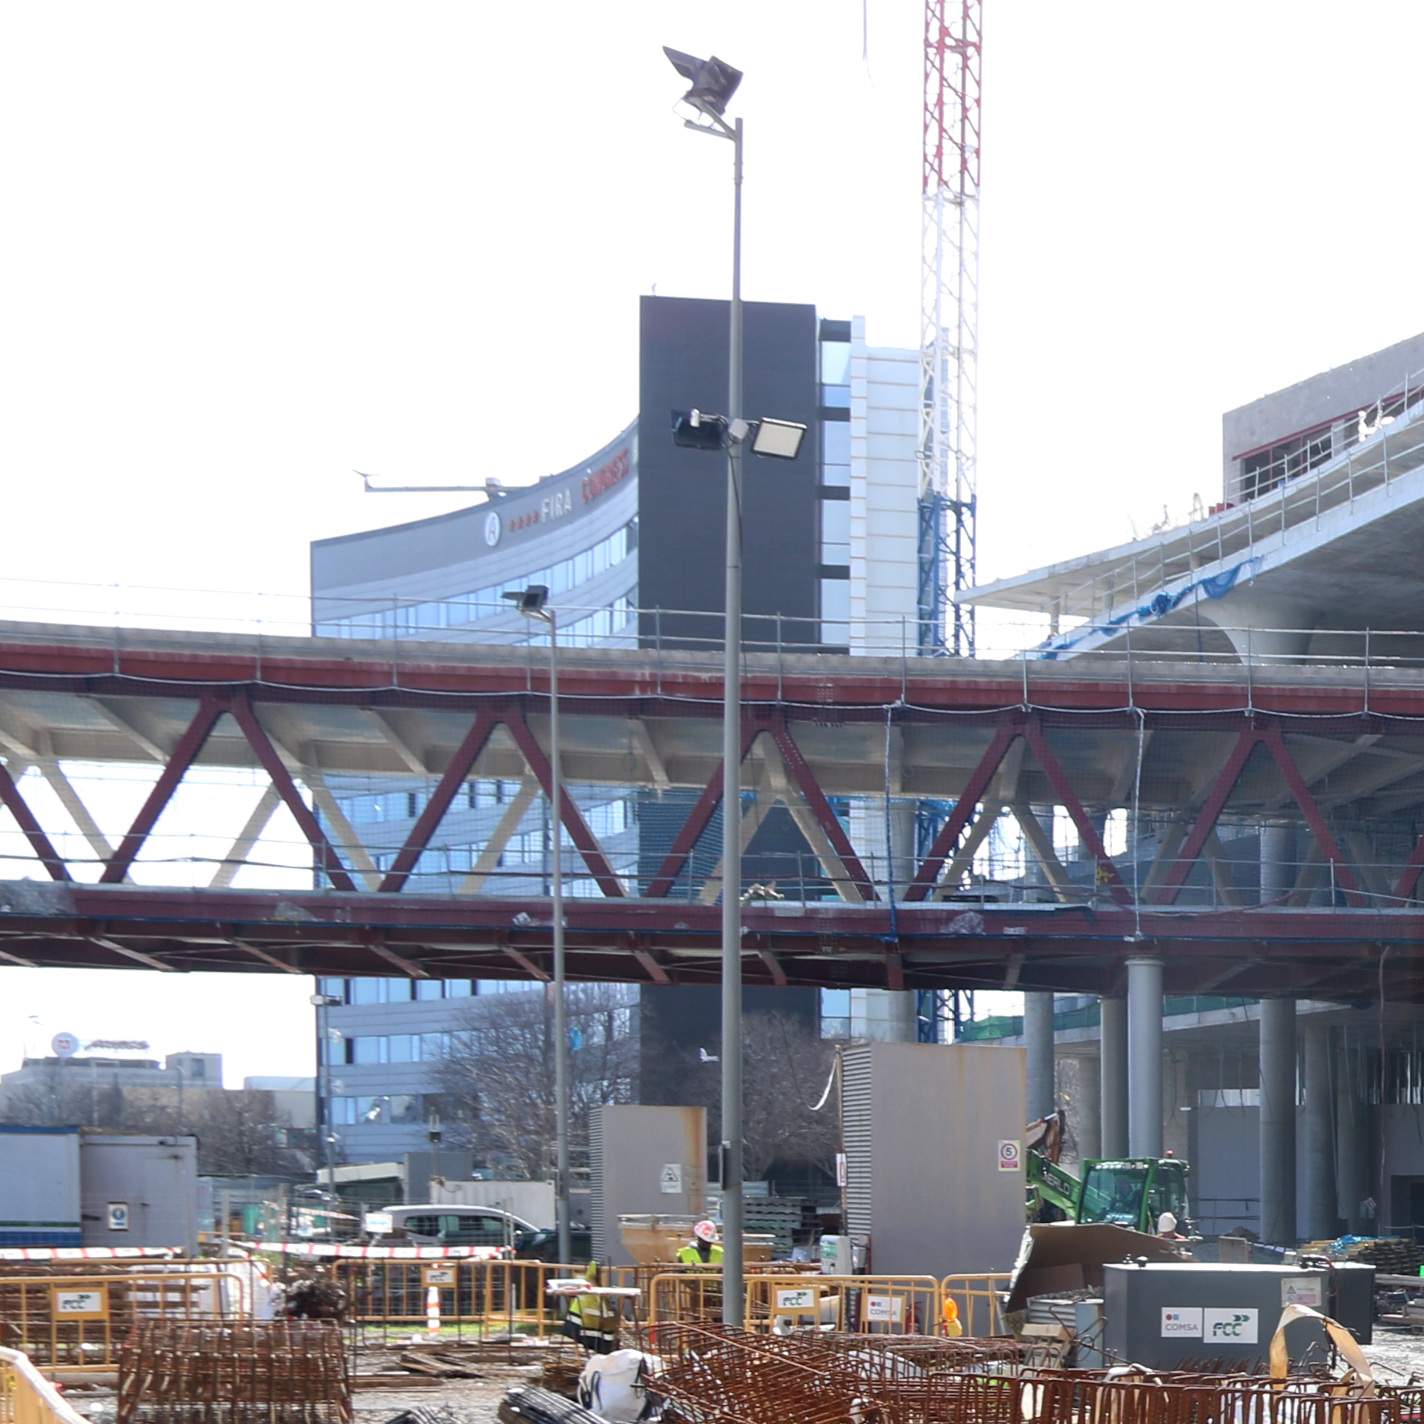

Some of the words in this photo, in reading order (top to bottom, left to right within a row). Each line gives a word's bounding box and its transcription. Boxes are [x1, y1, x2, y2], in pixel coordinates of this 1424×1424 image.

[541, 488, 572, 523] FIRA
[1165, 1323, 1198, 1331] COMSA
[1213, 1322, 1242, 1337] FCC
